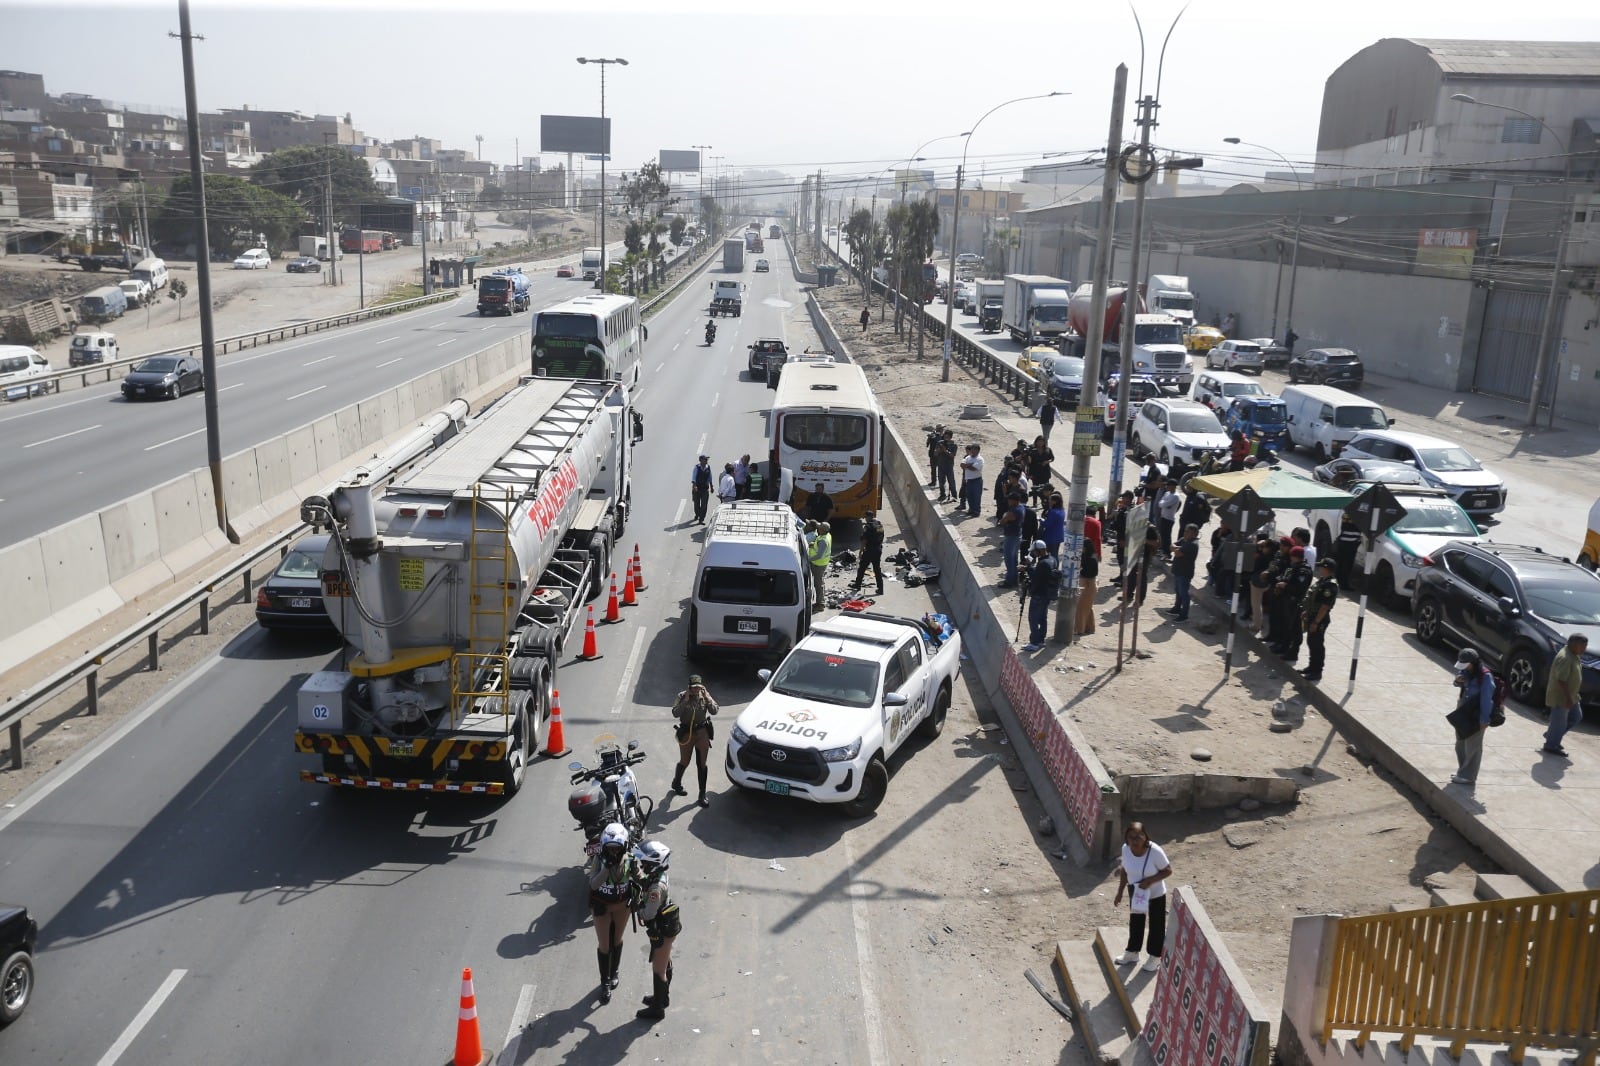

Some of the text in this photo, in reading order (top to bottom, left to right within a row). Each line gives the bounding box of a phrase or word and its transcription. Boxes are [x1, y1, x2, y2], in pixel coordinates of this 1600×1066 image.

[1424, 231, 1433, 245] SE
[528, 456, 580, 544] TRANSMAN
[314, 707, 328, 718] 02
[1081, 816, 1086, 832] 6
[1087, 828, 1092, 843] 6
[1164, 950, 1170, 968] 6
[1173, 965, 1182, 988] 6
[1183, 986, 1192, 1010] 6
[1147, 1022, 1158, 1043] 6
[1194, 1010, 1203, 1034] 6
[1156, 1042, 1167, 1064] 6
[1207, 1032, 1216, 1057] 6
